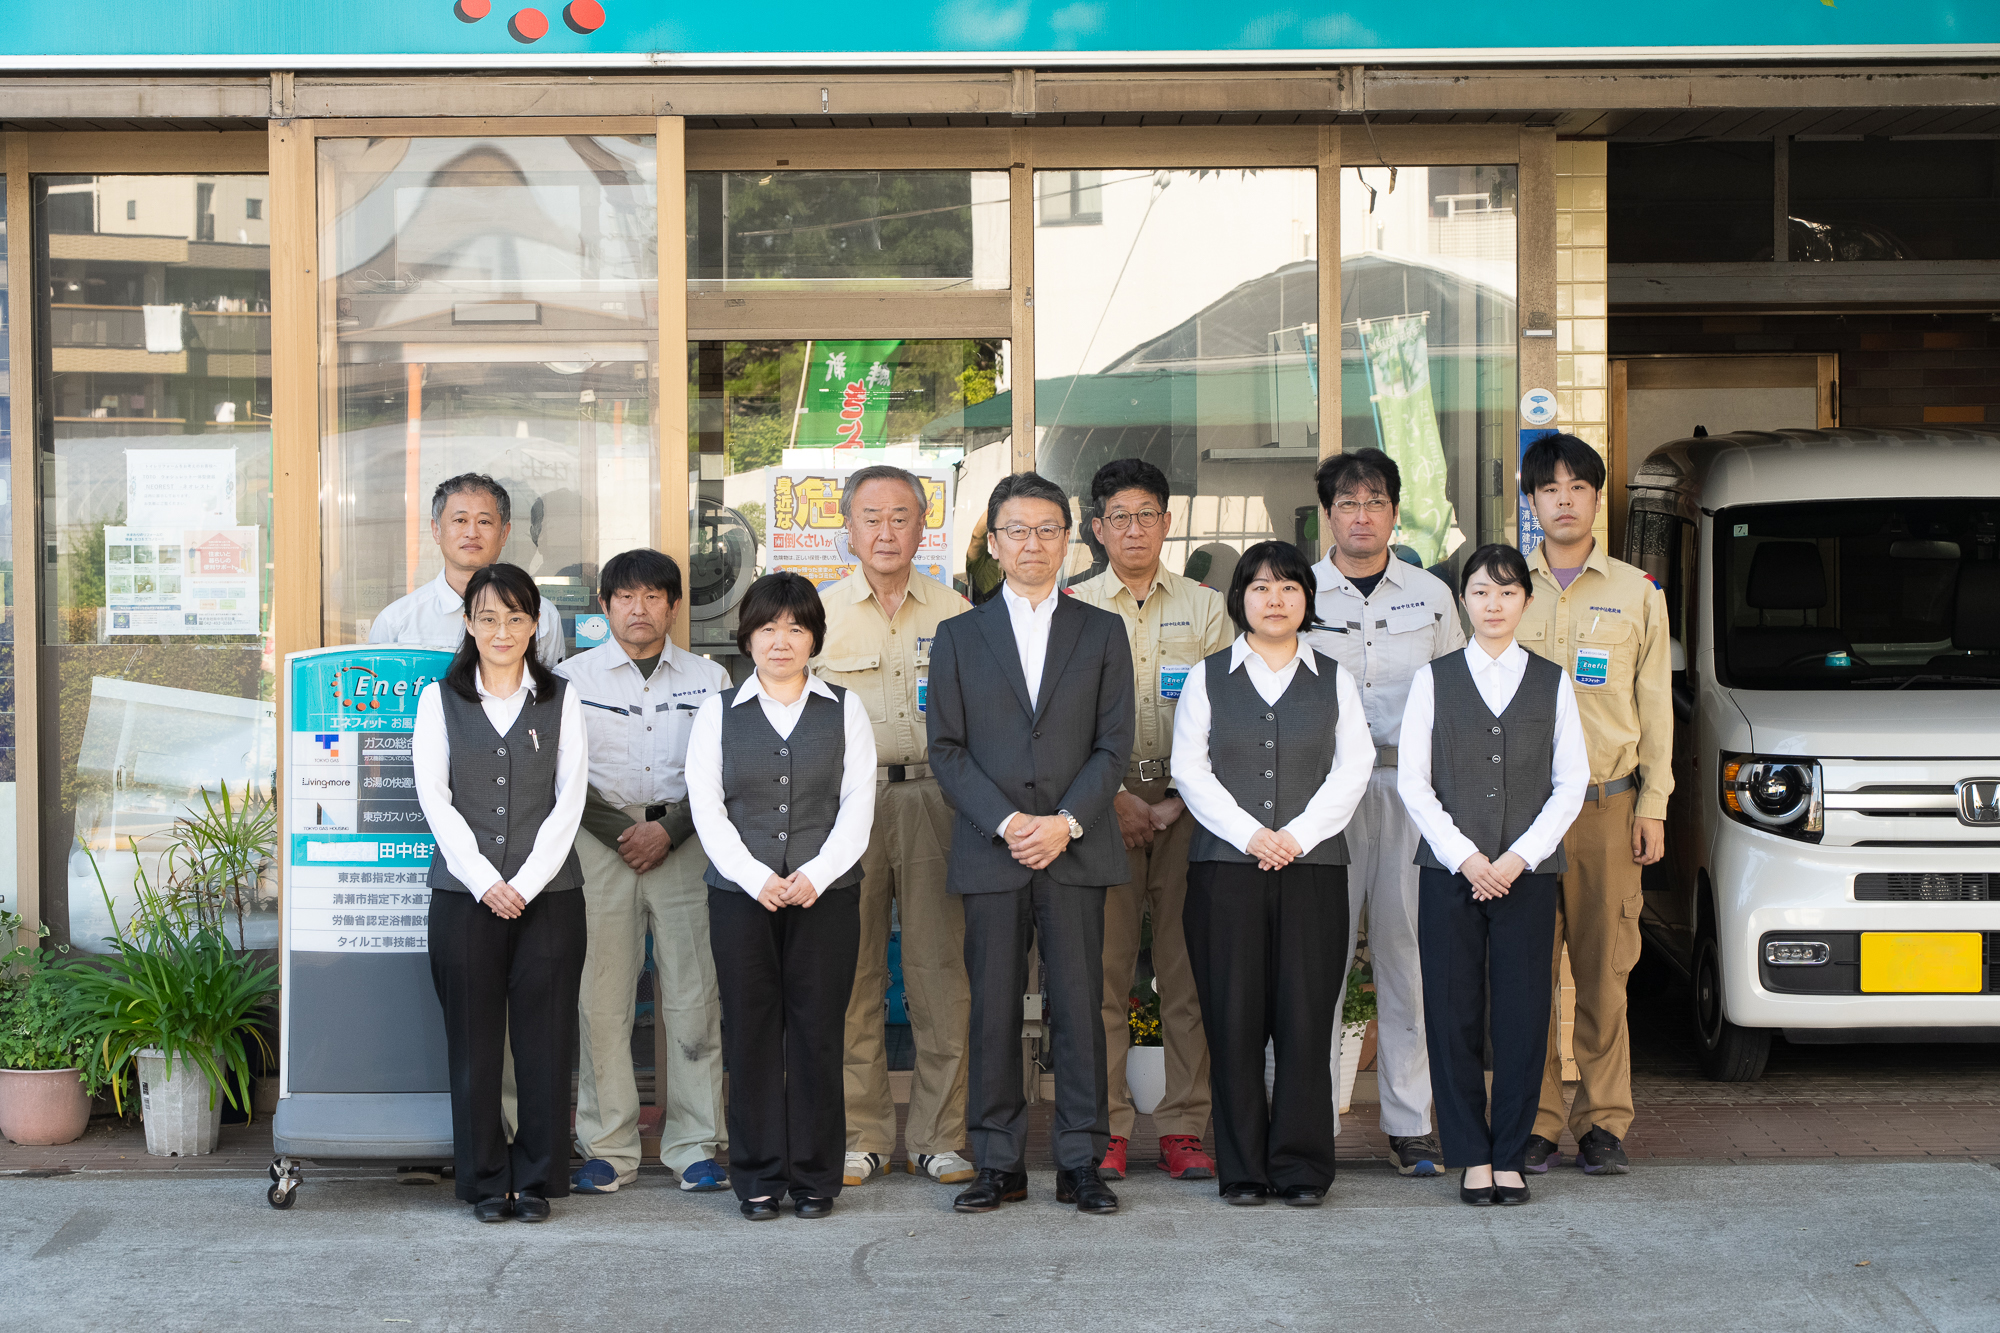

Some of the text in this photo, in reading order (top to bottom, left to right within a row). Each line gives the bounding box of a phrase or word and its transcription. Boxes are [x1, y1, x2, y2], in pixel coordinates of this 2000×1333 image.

[774, 477, 794, 530] 身近な
[773, 533, 833, 549] 面倒くさいが
[1521, 509, 1531, 560] 清瀬建設
[1582, 662, 1607, 670] Enefit
[330, 717, 417, 729] エネフィット お風
